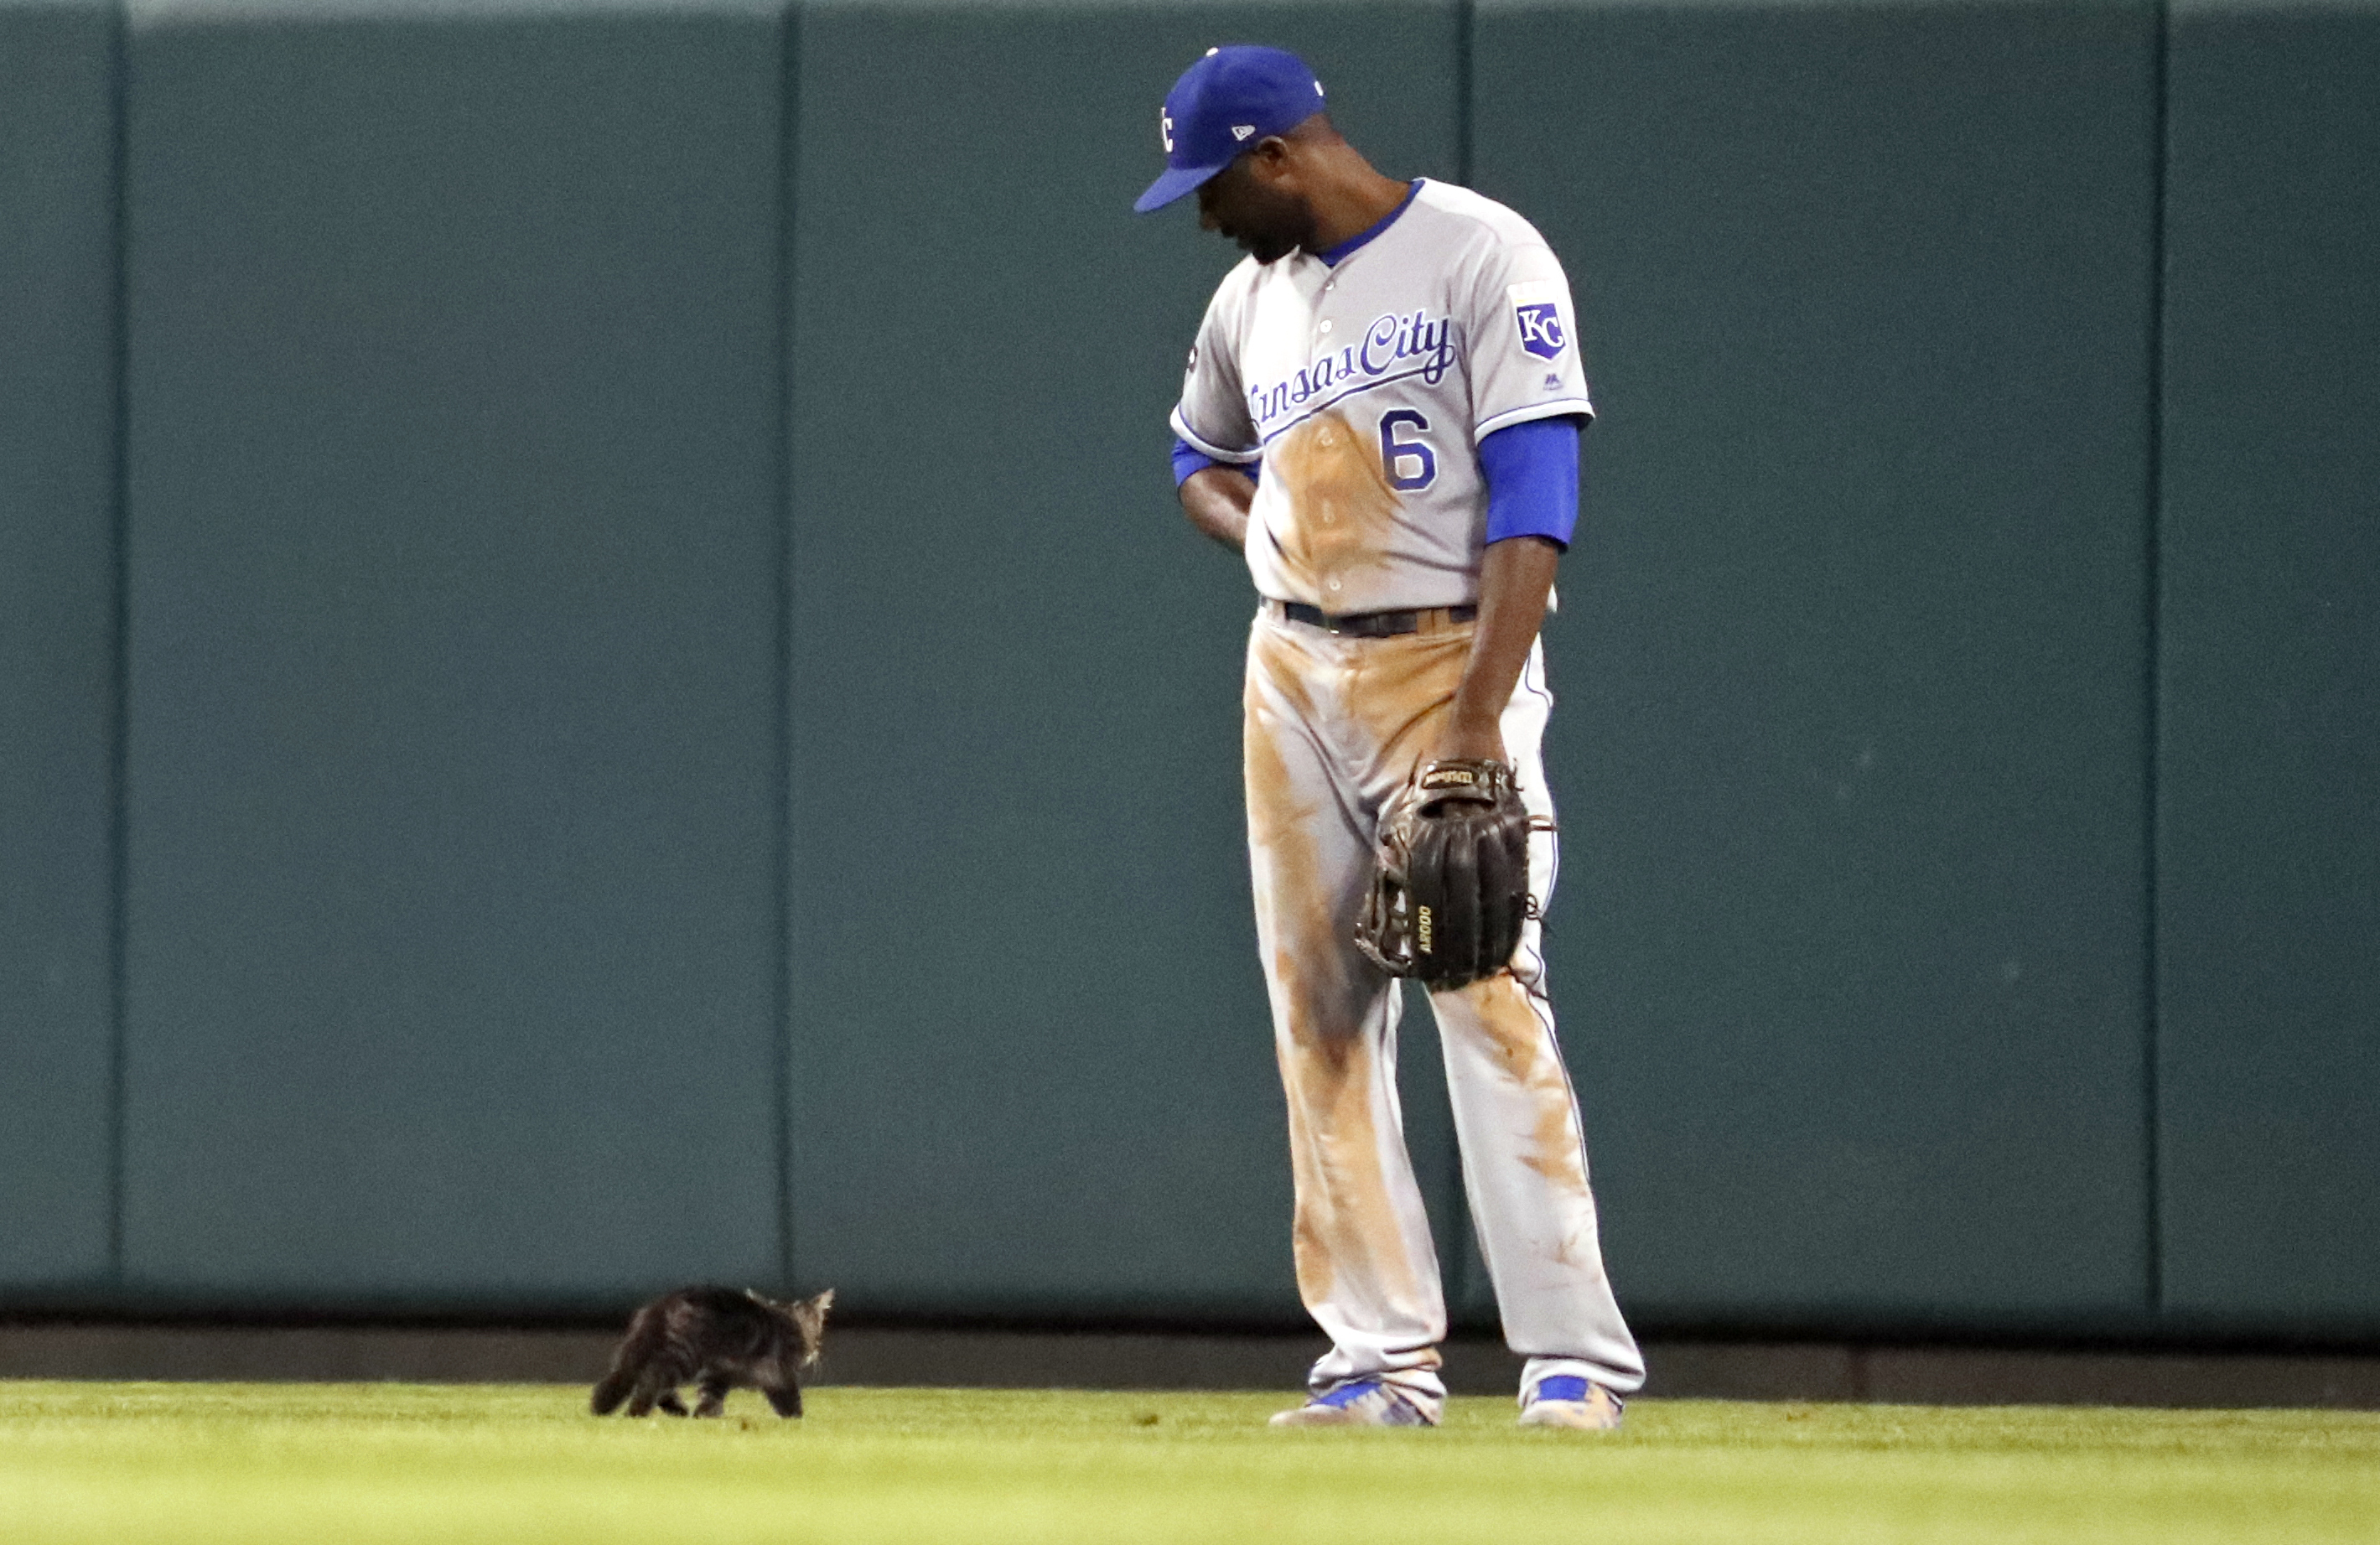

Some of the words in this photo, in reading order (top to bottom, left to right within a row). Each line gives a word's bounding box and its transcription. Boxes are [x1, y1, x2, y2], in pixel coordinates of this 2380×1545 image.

[1360, 310, 1456, 384] City
[1518, 309, 1564, 347] KC
[1380, 409, 1436, 491] 6
